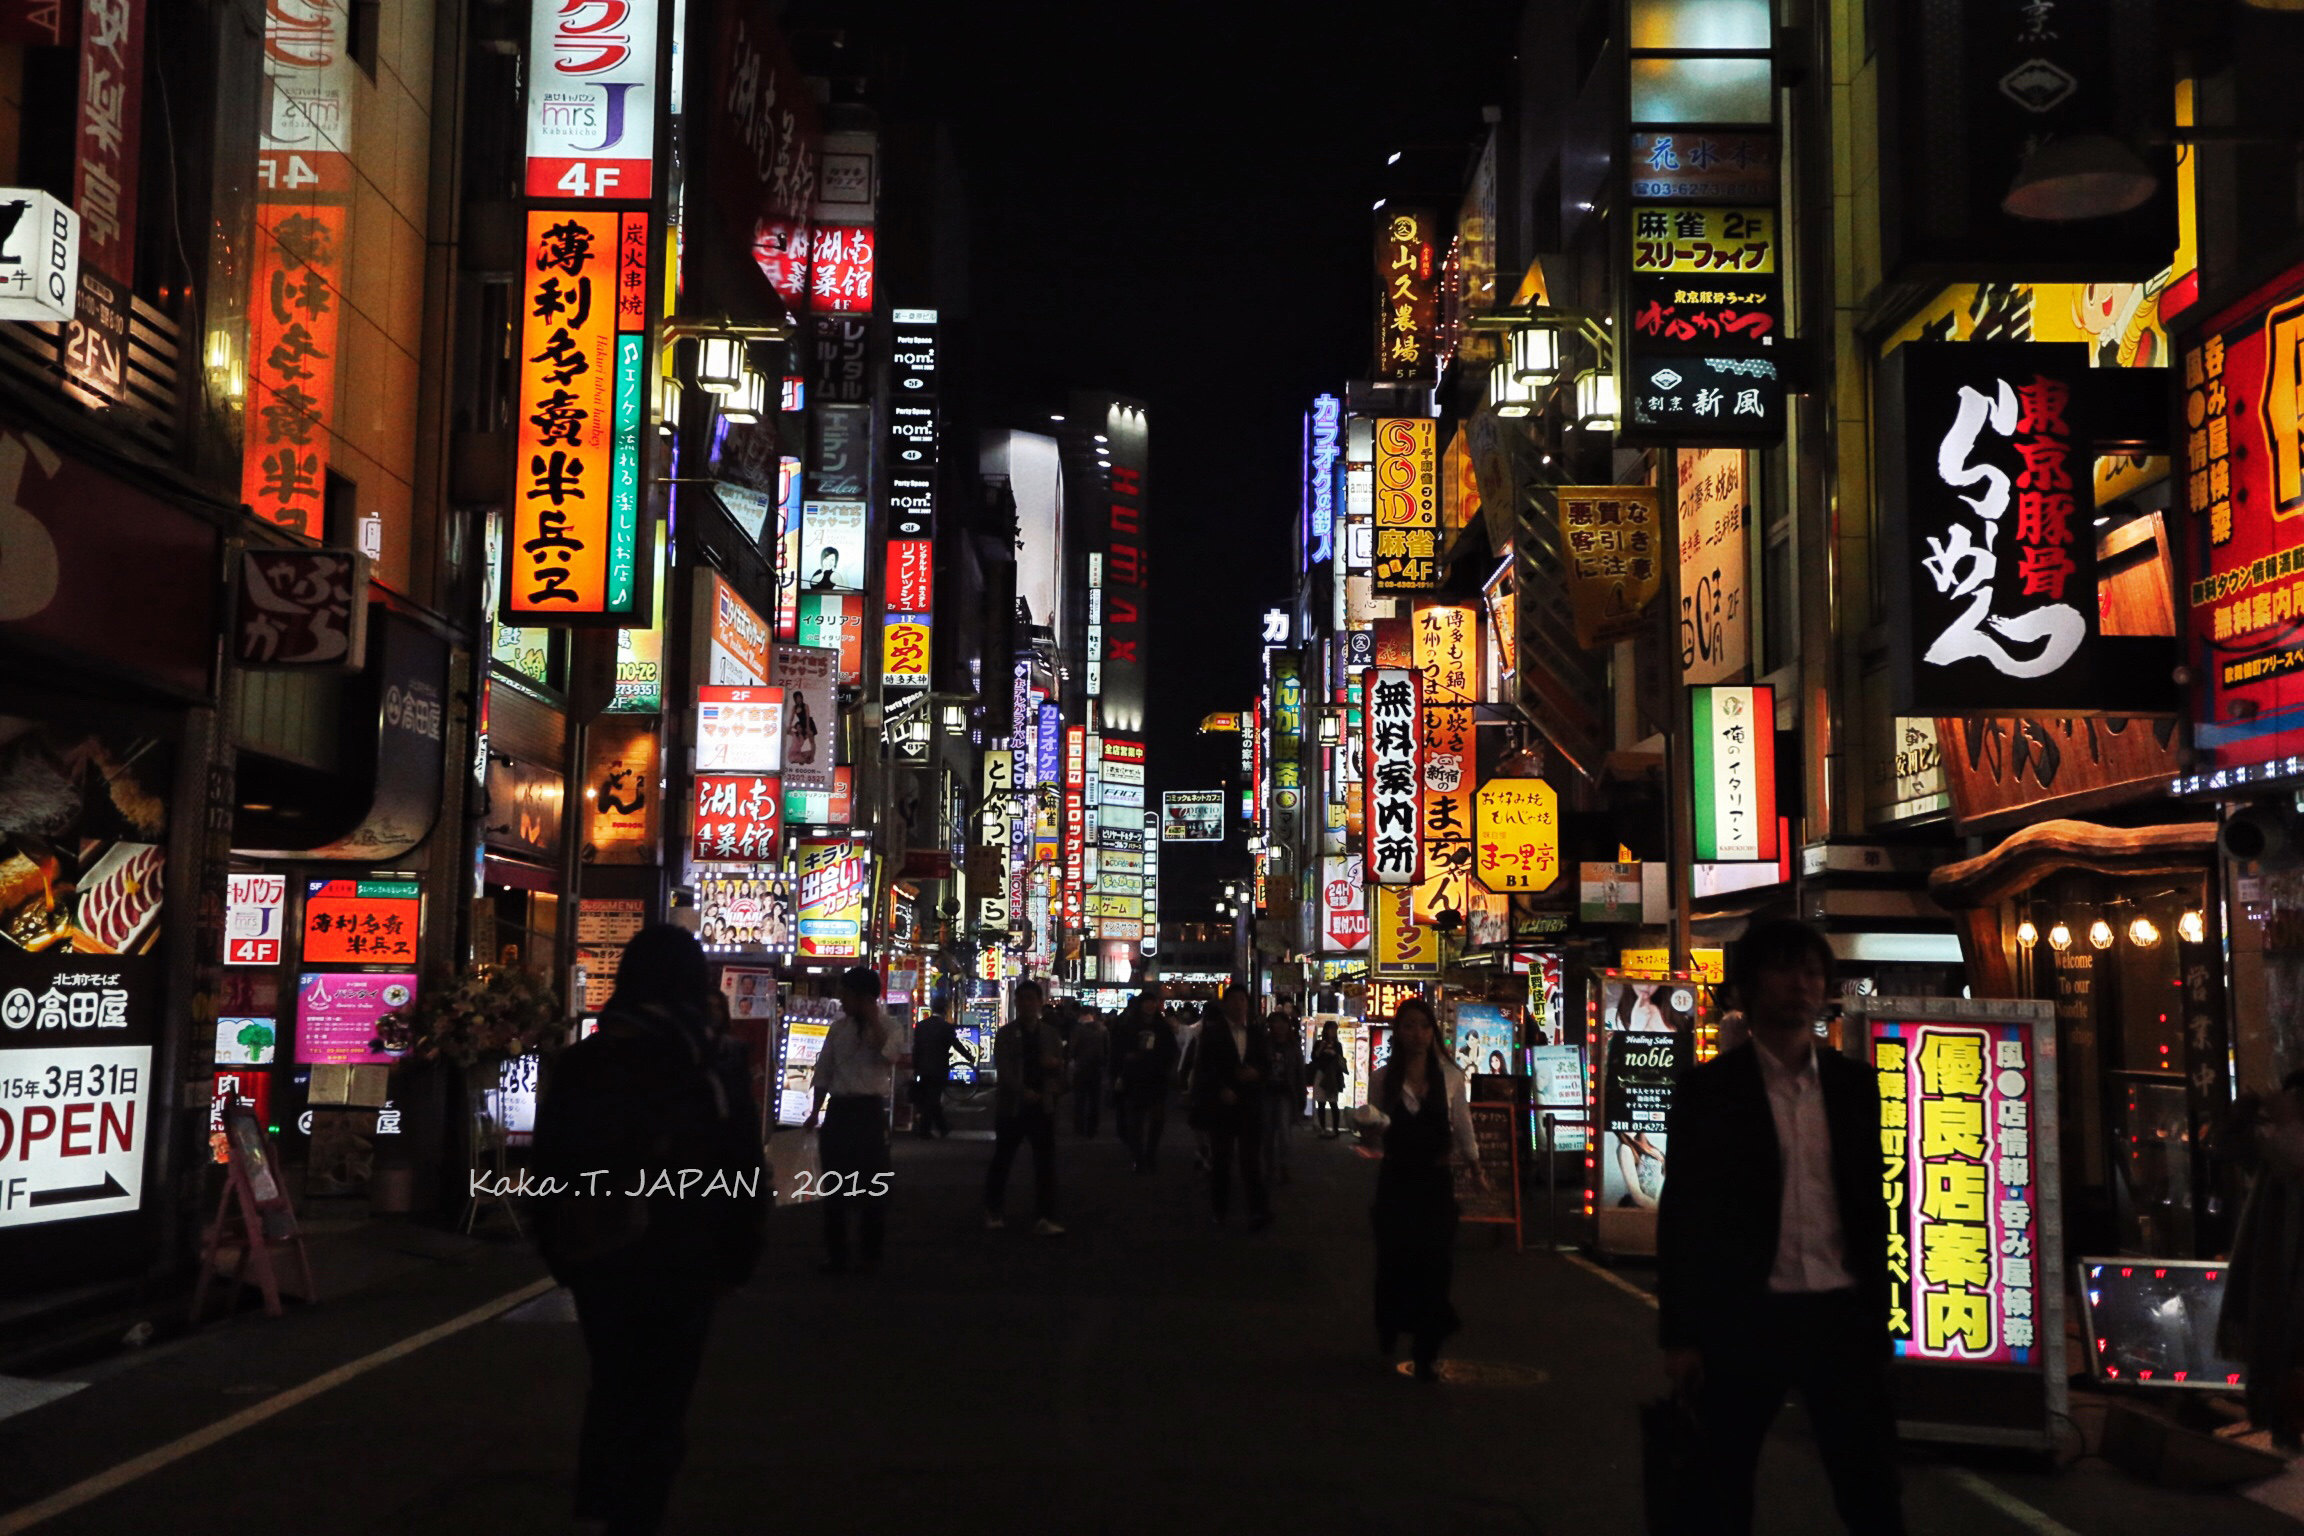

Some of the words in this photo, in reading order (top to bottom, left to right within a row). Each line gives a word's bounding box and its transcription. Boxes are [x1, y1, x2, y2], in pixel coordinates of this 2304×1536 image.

[557, 162, 621, 197] 4F
[1636, 210, 1706, 240] 麻雀
[1723, 212, 1762, 239] 2F
[49, 208, 69, 306] BBQ
[1635, 241, 1769, 270] スリーファイブ
[11, 269, 33, 291] 牛
[620, 224, 647, 315] 炭火串焼
[1391, 245, 1420, 363] 山久農場
[896, 407, 912, 416] Party
[1648, 396, 1683, 411] 割烹
[1692, 388, 1765, 417] 新風
[894, 480, 911, 488] Party
[911, 480, 929, 488] Space
[1378, 419, 1418, 525] GOD
[2014, 373, 2077, 600] 東京豚骨
[1568, 501, 1649, 525] 悪質な
[905, 523, 916, 532] 3F
[1377, 528, 1435, 558] 麻雀
[1569, 530, 1650, 552] 客引き
[900, 542, 915, 611] リフレッシュ
[1402, 559, 1434, 581] 4F
[1574, 555, 1653, 581] に注意
[802, 615, 862, 626] イタリアン
[900, 614, 916, 623] 1F
[1445, 609, 1466, 690] 博多もつ鍋
[731, 690, 752, 700] 2F
[703, 722, 778, 738] マッサージ
[1040, 704, 1058, 769] カラオケ
[1105, 744, 1144, 758] 全店営業中
[1242, 728, 1254, 772] 北の家族
[1039, 770, 1057, 781] 747
[1374, 680, 1417, 874] 無料案内所
[1722, 724, 1745, 841] 俺のイタリアン
[700, 778, 776, 821] 湖南
[1482, 791, 1544, 806] お好み焼
[1491, 810, 1553, 826] もんじゃ焼
[804, 841, 854, 870] キラリ
[1480, 842, 1555, 872] まつ里亭
[309, 882, 323, 891] 5F
[801, 859, 859, 906] 出会い
[1506, 875, 1530, 887] B1
[824, 888, 860, 918] カフェ
[1102, 903, 1127, 913] ゲーム
[237, 942, 272, 960] 4F
[52, 972, 121, 987] 北前そば
[301, 977, 313, 985] 3F
[36, 988, 129, 1030] 高田屋
[1501, 1008, 1511, 1018] 3F
[1625, 1047, 1675, 1068] noble
[1919, 1034, 1989, 1350] 優良店案内
